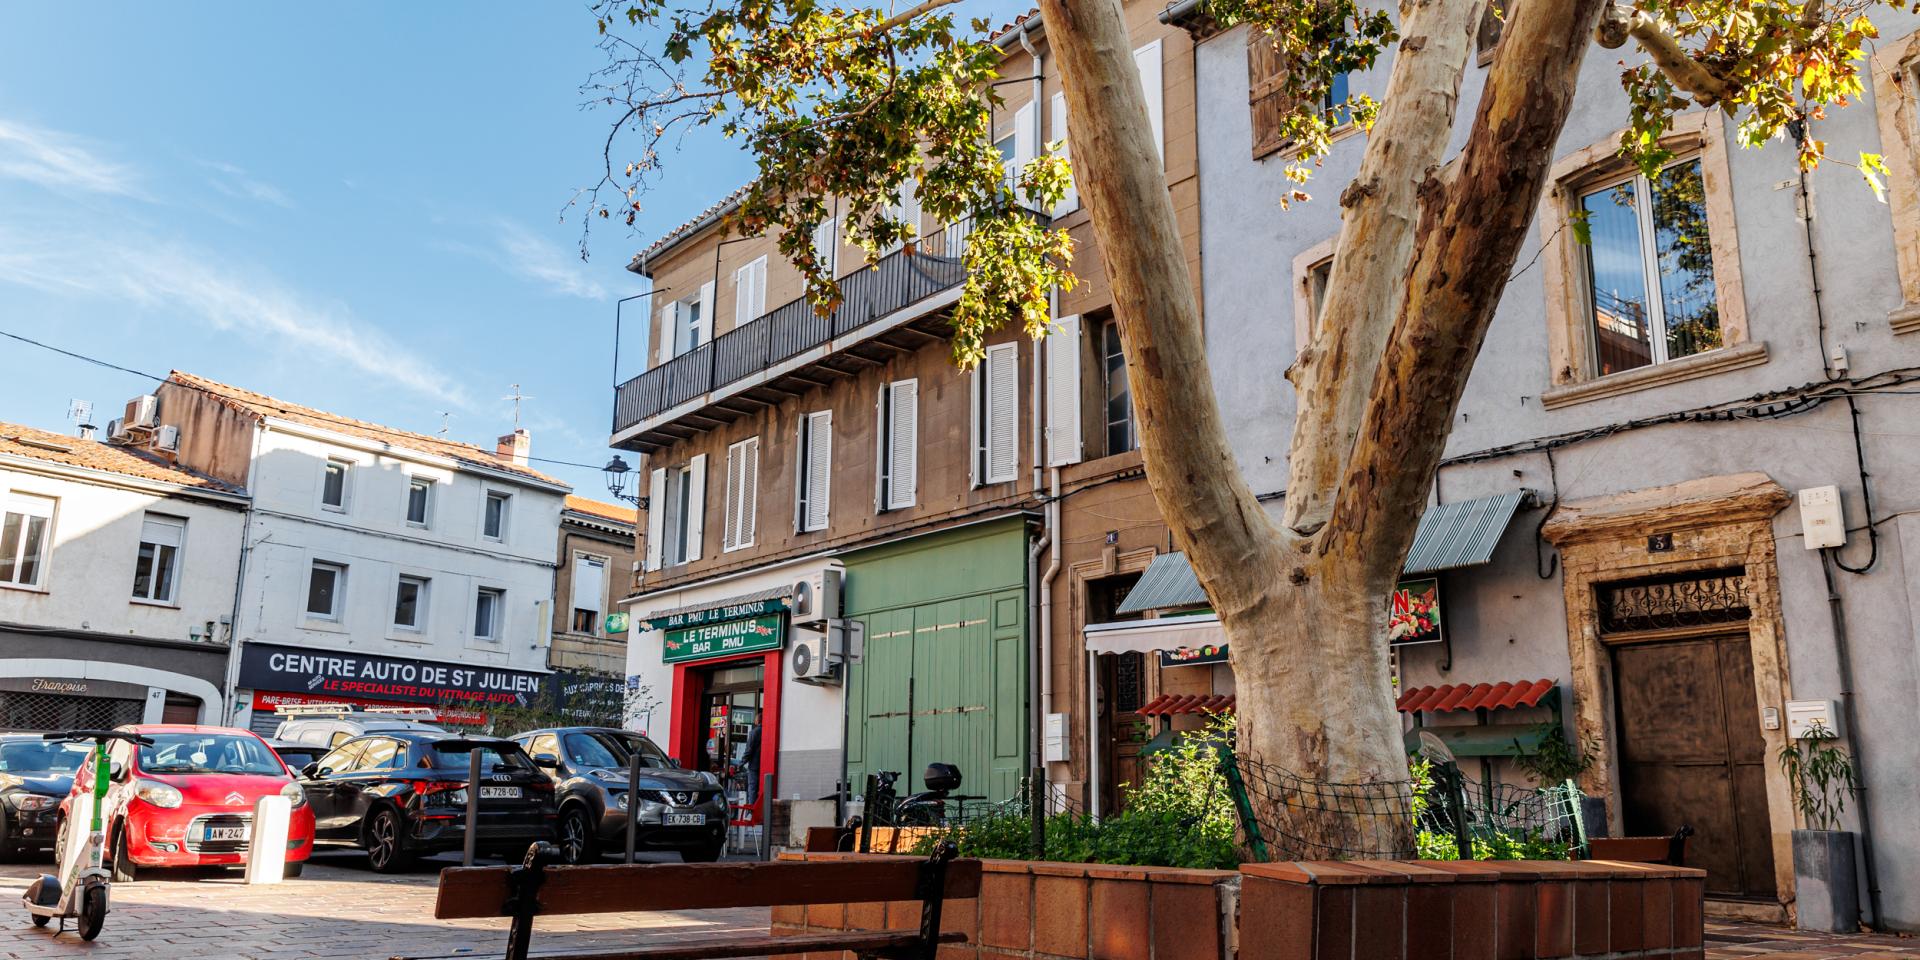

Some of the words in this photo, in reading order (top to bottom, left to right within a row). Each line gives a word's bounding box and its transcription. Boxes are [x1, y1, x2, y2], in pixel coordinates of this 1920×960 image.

[668, 614, 684, 626] BAR
[688, 611, 704, 623] PMU
[709, 609, 719, 620] LE
[723, 601, 765, 618] TERMINUS
[683, 629, 696, 643] LE
[699, 620, 757, 640] TERMINUS
[692, 641, 711, 653] BAR
[722, 636, 744, 649] PMU
[269, 653, 356, 677] CENTRE
[360, 661, 417, 682] AUTO
[421, 666, 447, 685] DE
[452, 669, 476, 687] ST
[479, 673, 539, 692] JULIEN
[31, 678, 88, 693] Françoise
[323, 679, 338, 690] LE
[340, 681, 417, 696] SPECIALISTE
[418, 687, 435, 697] DU
[437, 688, 486, 701] VITRAGE
[487, 693, 516, 704] AUTO
